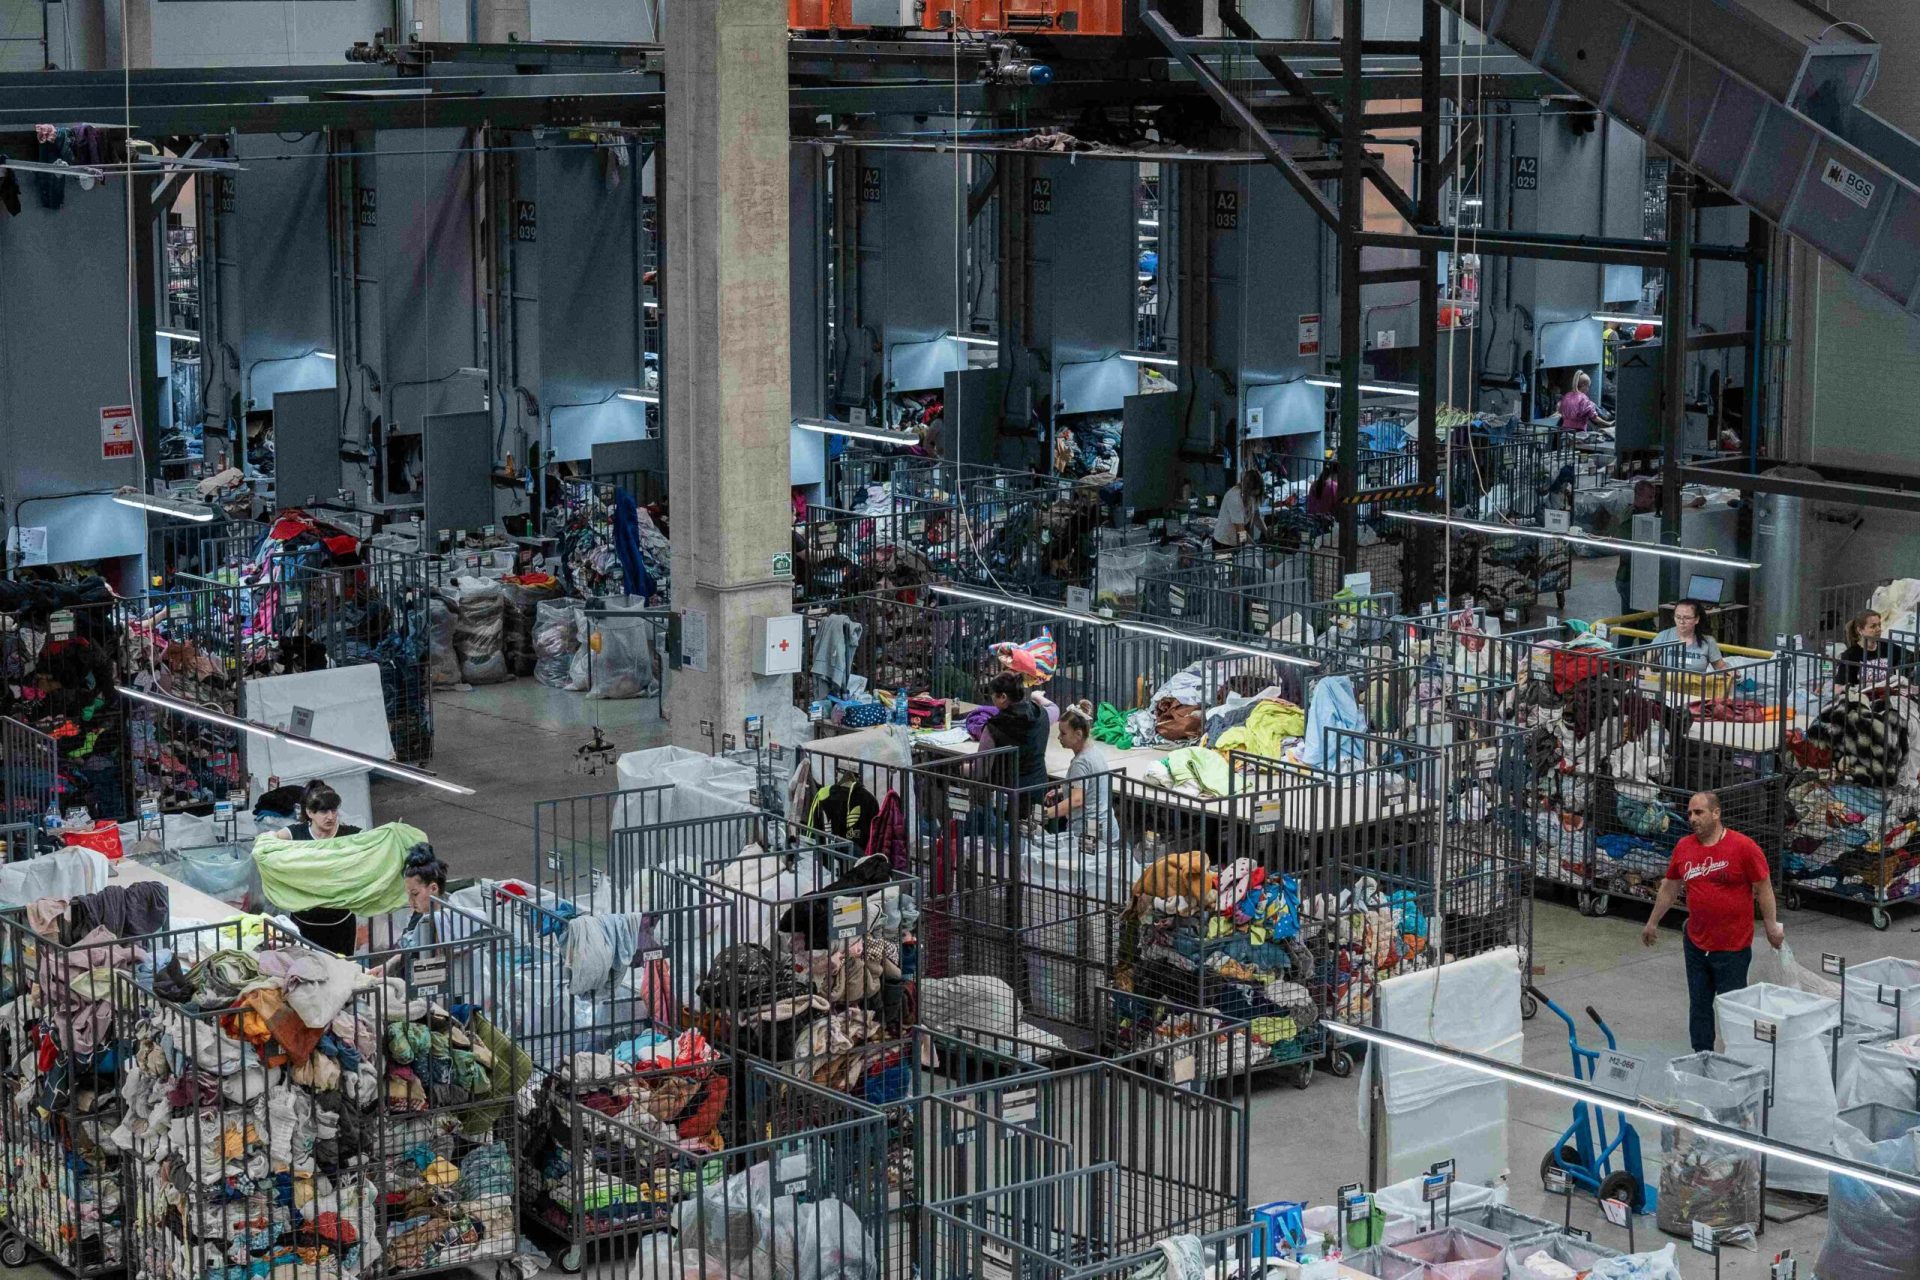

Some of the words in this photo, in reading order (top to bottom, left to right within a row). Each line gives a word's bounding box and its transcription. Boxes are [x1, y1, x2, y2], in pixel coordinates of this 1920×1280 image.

[1518, 158, 1536, 174] A2
[864, 170, 880, 185] A2
[1517, 175, 1536, 189] 029
[1846, 173, 1872, 196] BGS
[222, 178, 235, 194] A2
[1033, 180, 1050, 195] A2
[362, 191, 376, 207] A2
[1033, 199, 1051, 213] 034
[1217, 194, 1236, 209] A2
[361, 211, 377, 225] 038
[519, 203, 536, 221] A2
[1216, 213, 1236, 227] 035
[519, 225, 537, 240] 039
[1609, 1056, 1635, 1070] M2-066
